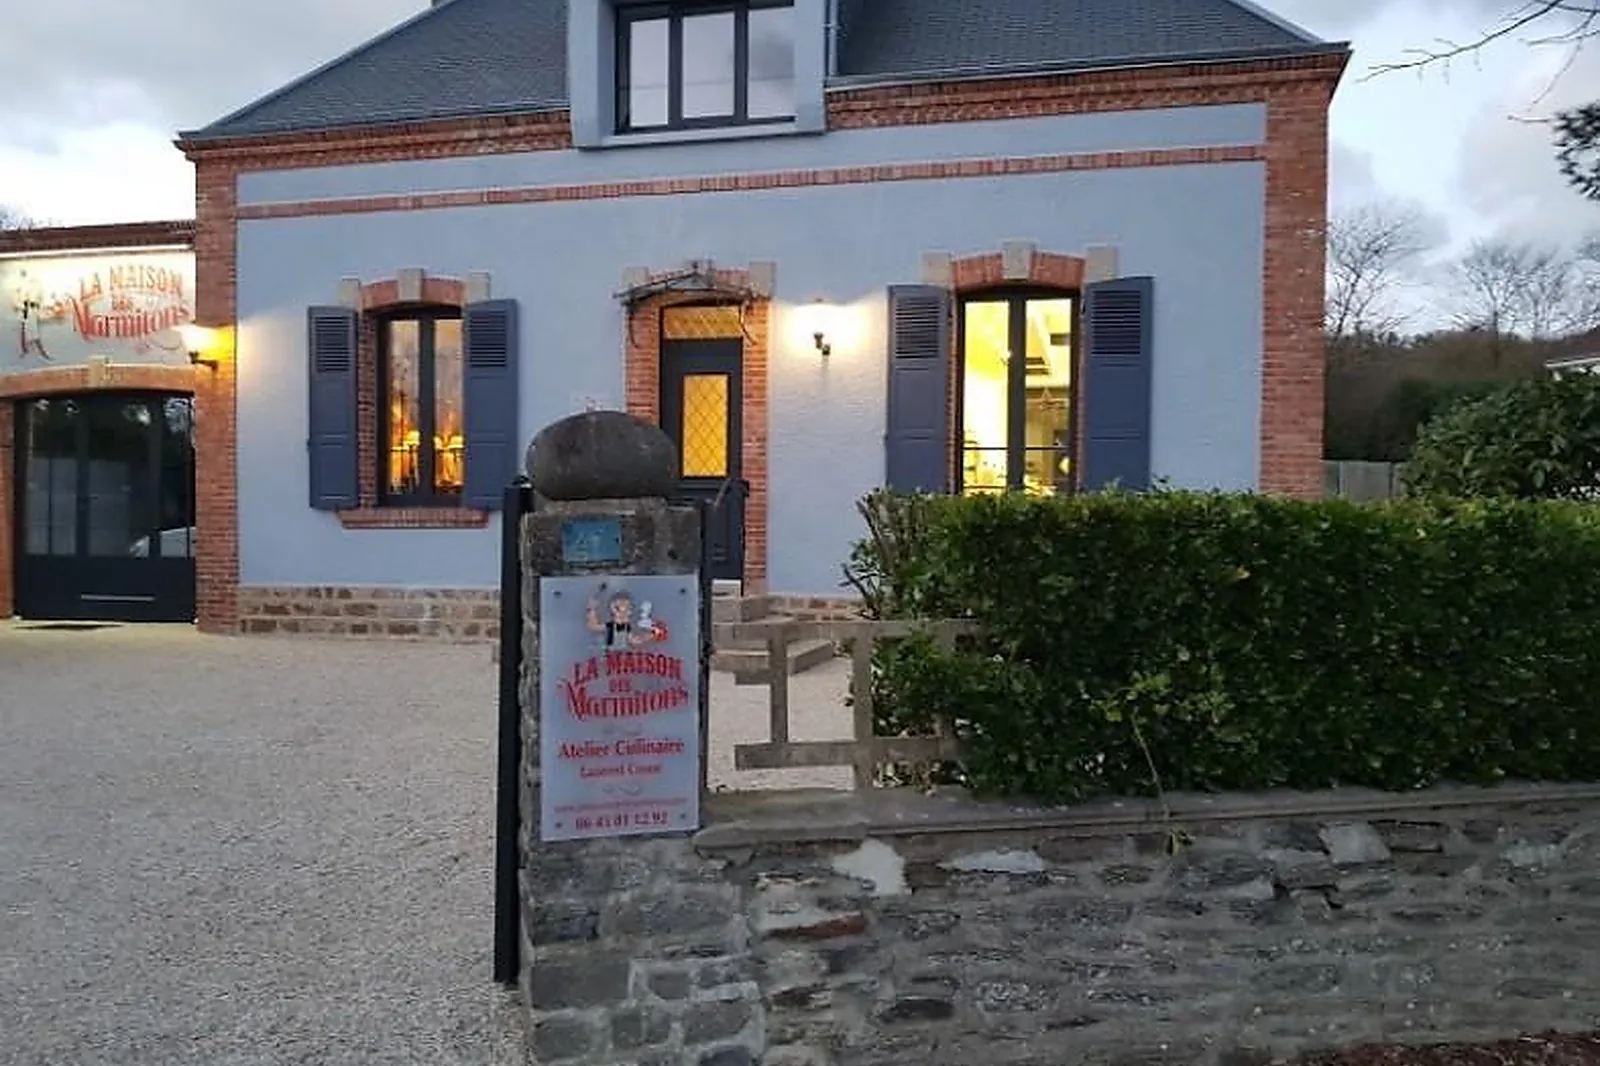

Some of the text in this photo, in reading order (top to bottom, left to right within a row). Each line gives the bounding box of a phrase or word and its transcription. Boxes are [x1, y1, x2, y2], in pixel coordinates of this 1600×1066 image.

[80, 265, 183, 302] LA MAISON
[573, 652, 683, 686] LA MAISON
[609, 679, 632, 693] DES
[566, 682, 689, 721] Marmitons
[558, 737, 685, 759] Atelier Culinaire
